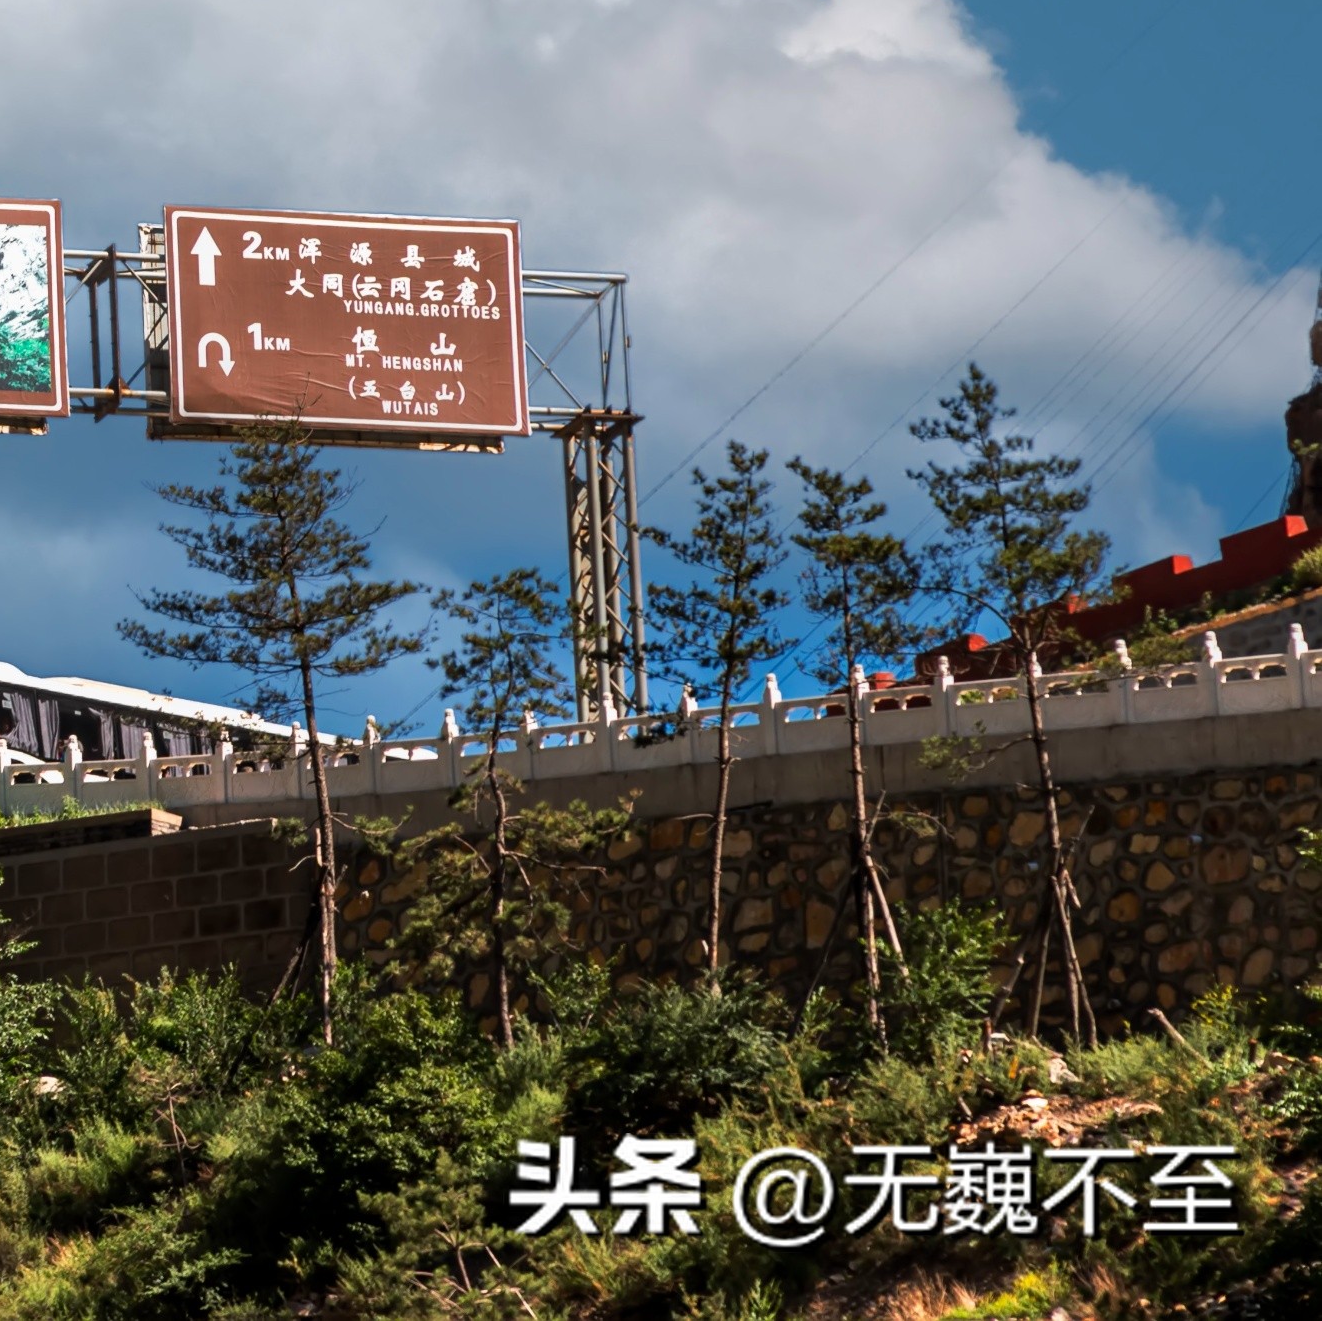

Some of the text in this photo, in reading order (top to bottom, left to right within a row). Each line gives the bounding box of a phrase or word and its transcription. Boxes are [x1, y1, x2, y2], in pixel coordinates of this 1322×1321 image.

[298, 237, 480, 273] 浑源县城
[247, 322, 457, 356] 1KM 恒山
[345, 353, 463, 373] MT. HENGSHAN
[382, 400, 439, 416] WUTAIS
